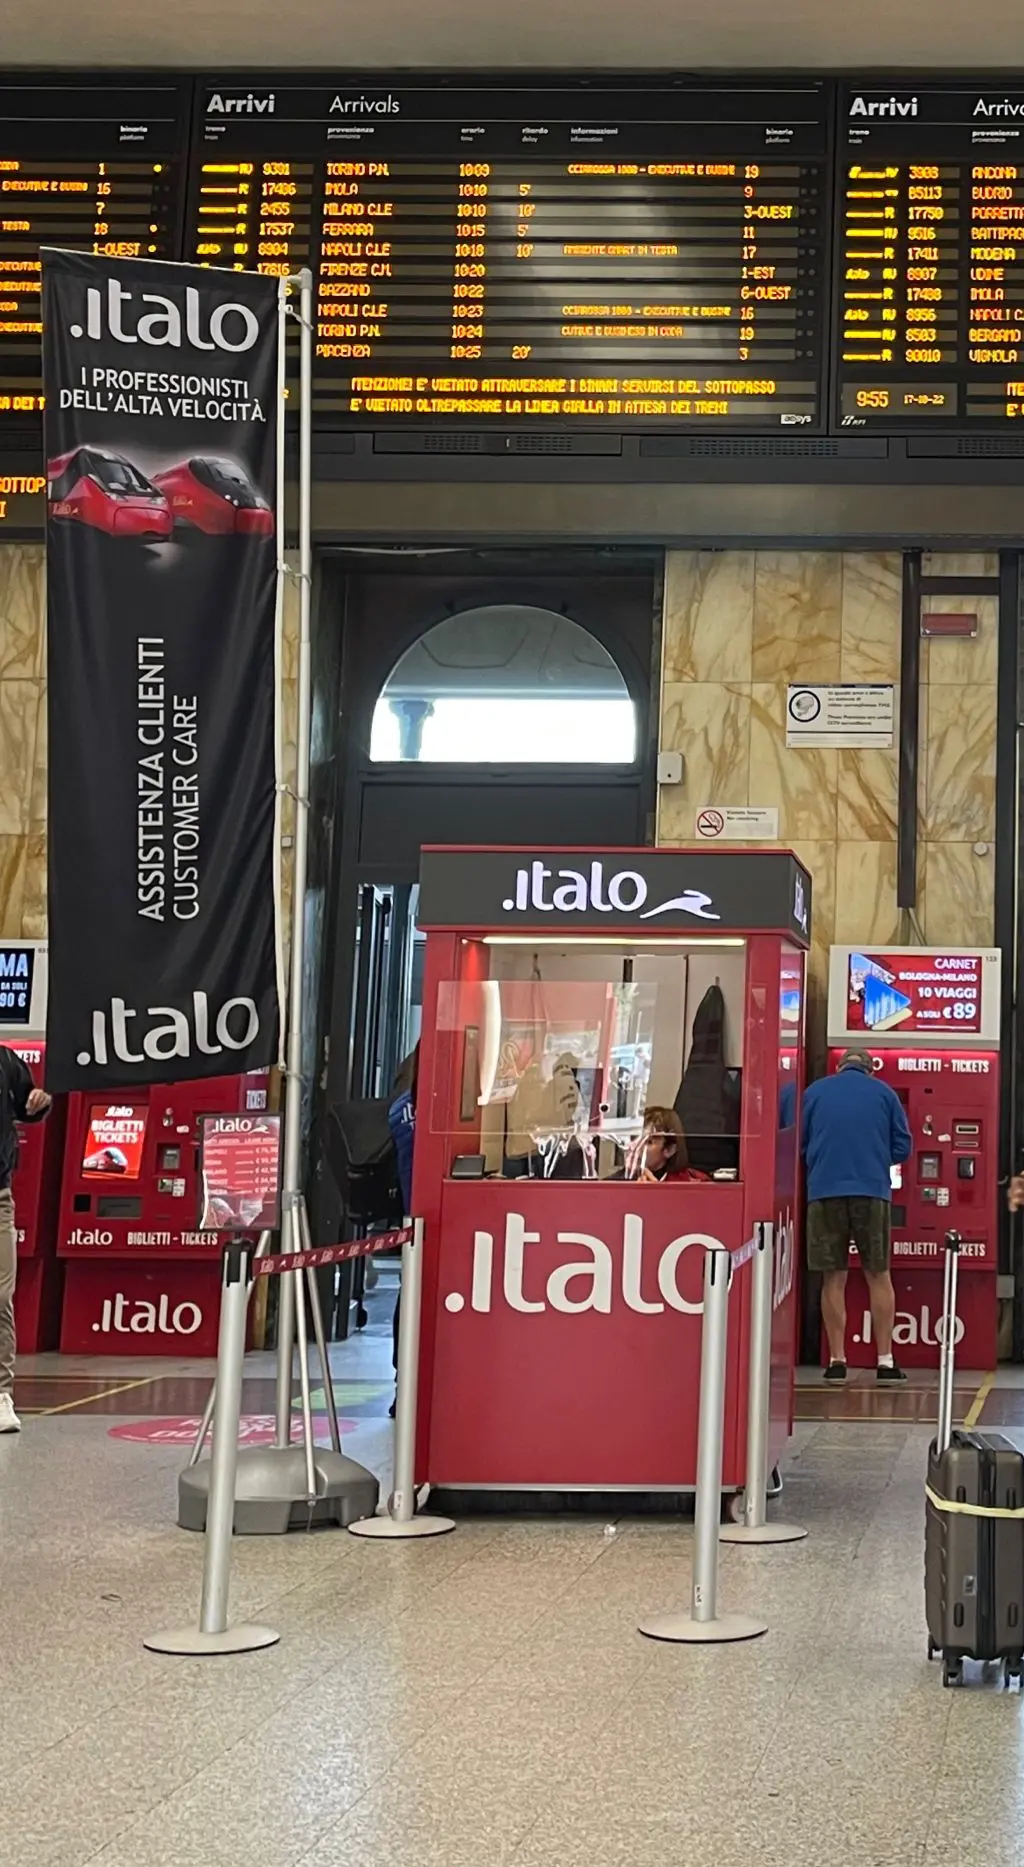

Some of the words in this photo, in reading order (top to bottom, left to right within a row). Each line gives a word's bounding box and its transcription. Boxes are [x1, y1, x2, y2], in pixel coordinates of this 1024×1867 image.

[207, 94, 275, 113] Arrivi
[329, 94, 400, 113] Arrivals
[850, 97, 918, 116] Arrivi
[746, 166, 759, 178] 19
[973, 167, 1016, 179] ANCONA
[326, 183, 358, 195] IMOLA
[972, 187, 1012, 199] BUDRIO
[324, 203, 364, 215] MILANO
[323, 223, 373, 235] FERRARA
[322, 243, 361, 256] NAPOLI
[744, 246, 756, 258] 17
[971, 248, 1015, 260] MODENA
[320, 263, 368, 276] FIRENZE
[744, 267, 773, 279] 1-EST
[971, 288, 1003, 300] IMOLA
[971, 309, 1009, 320] NAPOLI
[741, 327, 754, 340] 19
[969, 329, 1021, 341] BERGAMO
[317, 345, 370, 357] PIACENZA
[971, 349, 1017, 362] VIGNOLA
[81, 367, 86, 386] I
[93, 368, 249, 399] PROFESSIONISTI
[60, 389, 163, 416] DELL'ALTA
[857, 391, 888, 407] 9:55
[366, 398, 412, 412] VIETATO
[416, 399, 502, 412] OLTREPASSARE
[506, 400, 522, 412] LA
[562, 400, 605, 413] GIALLA
[623, 400, 668, 413] ATTESA
[669, 400, 693, 413] DEI
[138, 638, 164, 745] CLIENTI
[172, 695, 198, 766] CARE
[138, 752, 165, 922] ASSISTENZA
[173, 774, 200, 920] CUSTOMER
[934, 958, 977, 969] CARNET
[918, 987, 932, 999] 10
[934, 987, 977, 999] VIAGGI
[898, 1058, 942, 1072] BIGLIETTI
[952, 1059, 989, 1073] TICKETS
[91, 1120, 144, 1132] BIGLIETTI
[95, 1132, 138, 1144] TICKETS
[127, 1232, 170, 1246] BIGLIETTI
[181, 1232, 217, 1246] TICKETS
[893, 1242, 937, 1256] BIGLIETTI
